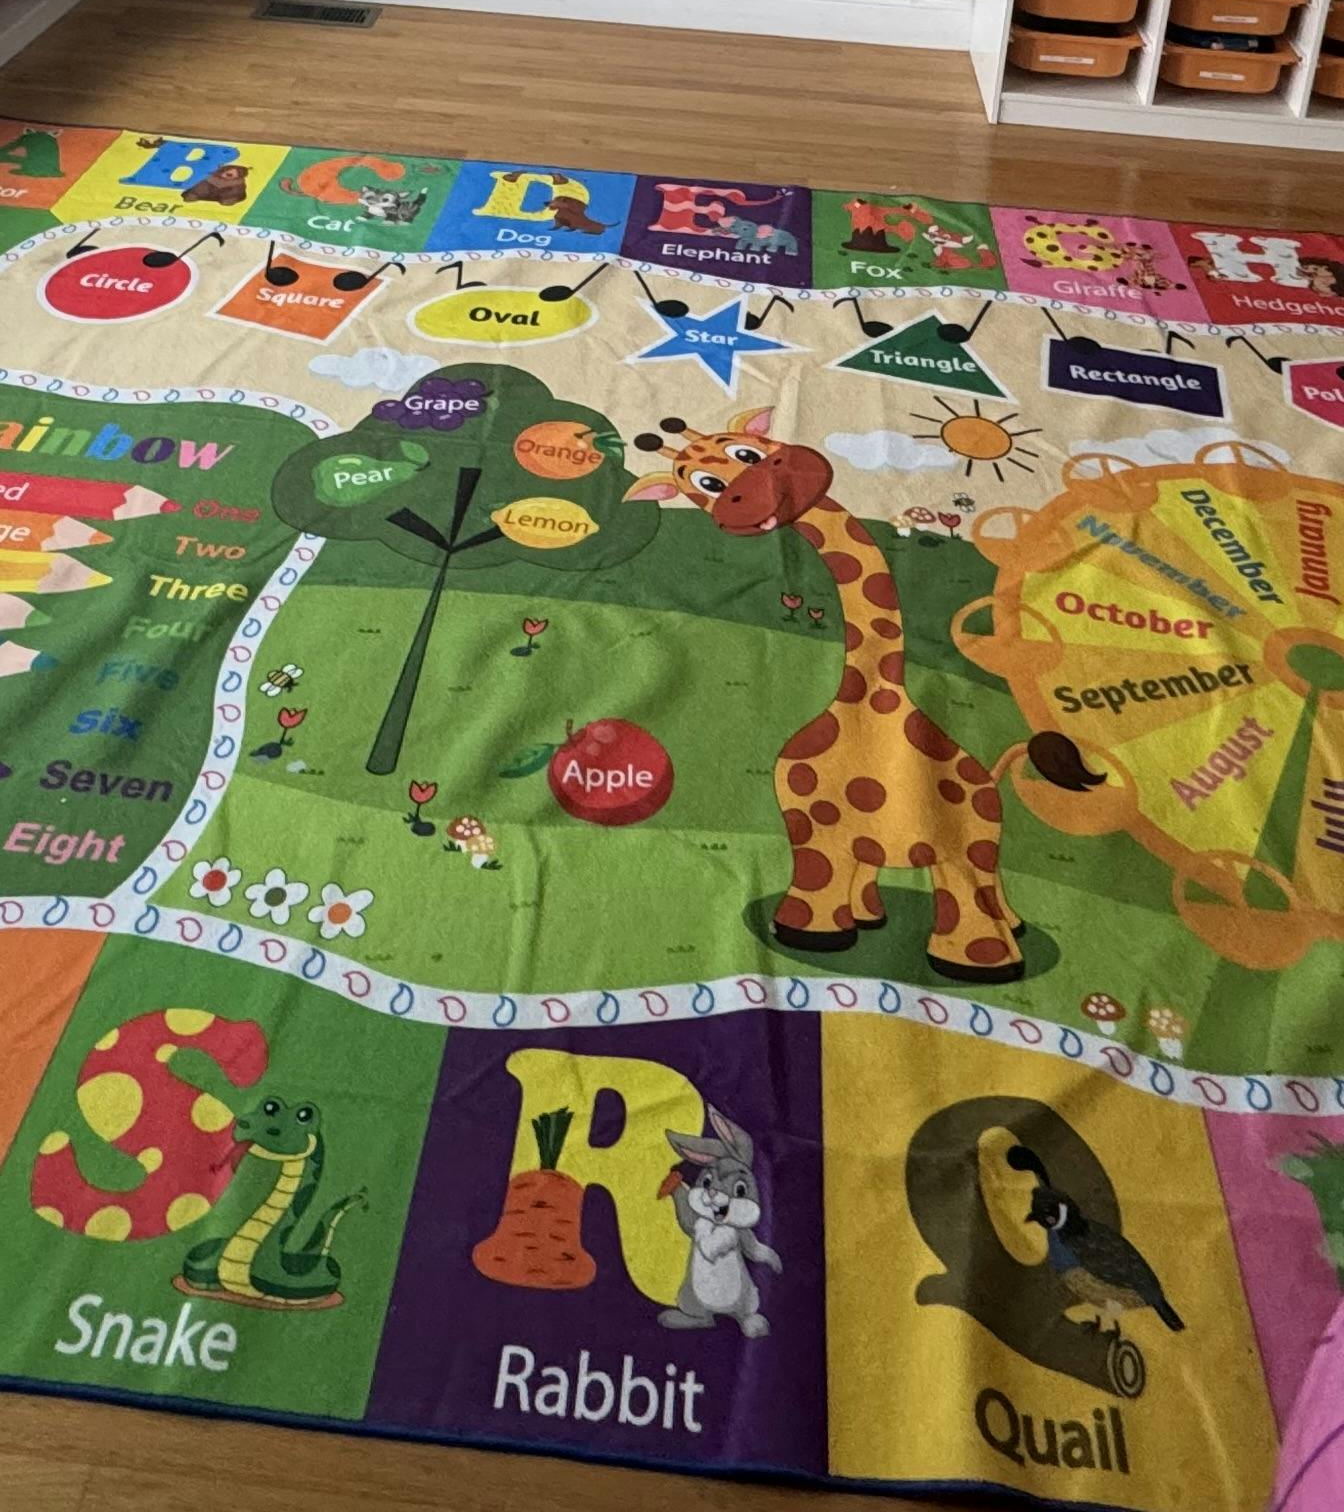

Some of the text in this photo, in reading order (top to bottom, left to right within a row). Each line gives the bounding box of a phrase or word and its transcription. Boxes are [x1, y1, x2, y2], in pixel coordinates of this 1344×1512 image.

[297, 155, 407, 206] C
[114, 195, 186, 216] Bear
[307, 214, 354, 234] Cat
[496, 228, 553, 248] Dog
[662, 242, 773, 266] Elephant
[80, 272, 153, 295] Circle
[850, 260, 904, 280] Fox
[255, 286, 345, 310] Square
[468, 306, 541, 328] Oval
[684, 328, 740, 348] Star
[869, 349, 977, 375] Triangle
[1069, 364, 1202, 391] Rectangle
[403, 393, 481, 417] Grape
[515, 438, 602, 466] Orange
[332, 464, 394, 490] Pear
[192, 498, 262, 523] One
[502, 509, 591, 536] Lemon
[175, 535, 247, 561] Two
[1179, 488, 1285, 608] December
[1294, 498, 1343, 606] January
[148, 573, 250, 603] Three
[1054, 591, 1214, 641] October
[1053, 661, 1256, 716] September
[561, 759, 655, 793] Apple
[1169, 714, 1276, 813] August
[38, 758, 176, 803] Seven
[1, 822, 129, 866] Eight
[54, 1293, 239, 1372] Snake
[493, 1343, 706, 1434] Rabbit
[974, 1386, 1133, 1475] Quail
